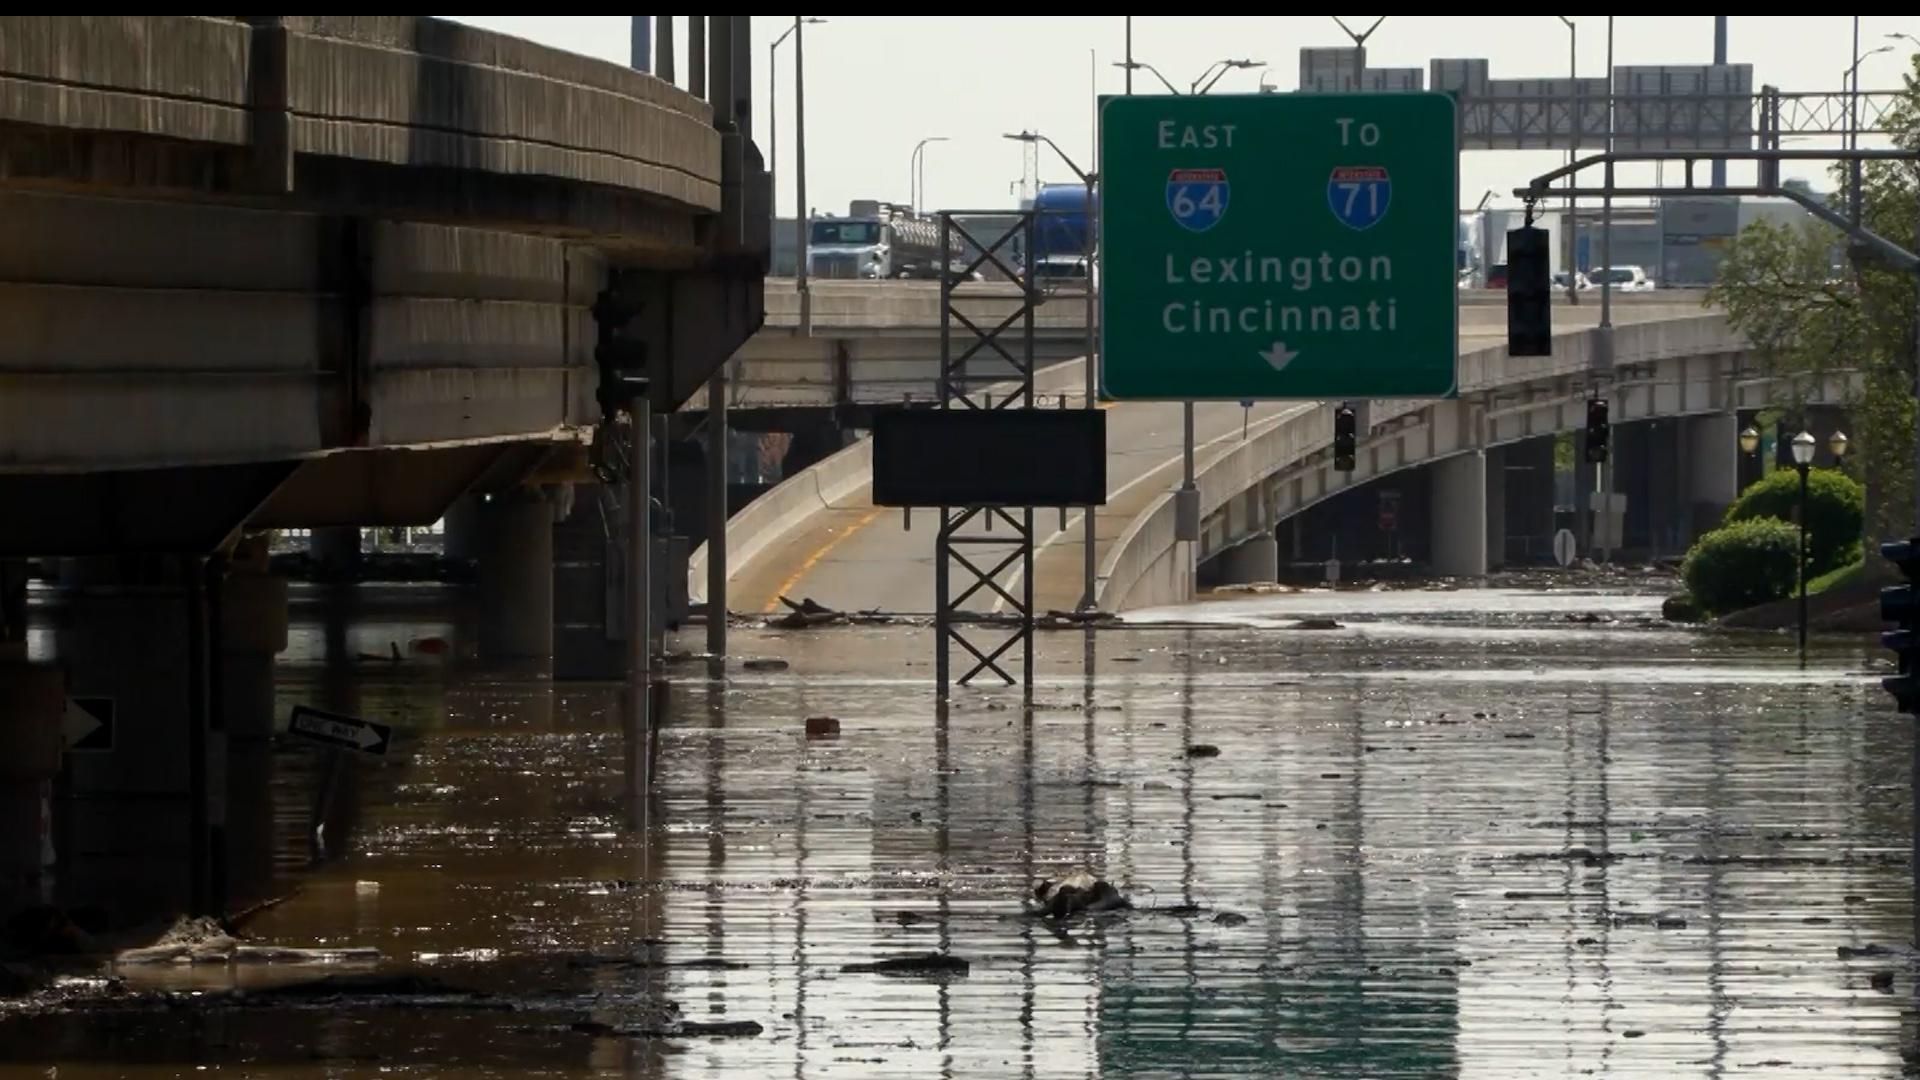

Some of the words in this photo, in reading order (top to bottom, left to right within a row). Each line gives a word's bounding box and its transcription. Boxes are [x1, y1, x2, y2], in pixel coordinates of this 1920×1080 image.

[1158, 120, 1238, 149] EAST
[1172, 185, 1223, 219] 64
[1338, 183, 1380, 217] 71
[1166, 251, 1392, 291] Lexington
[1162, 300, 1397, 333] Cincinnati
